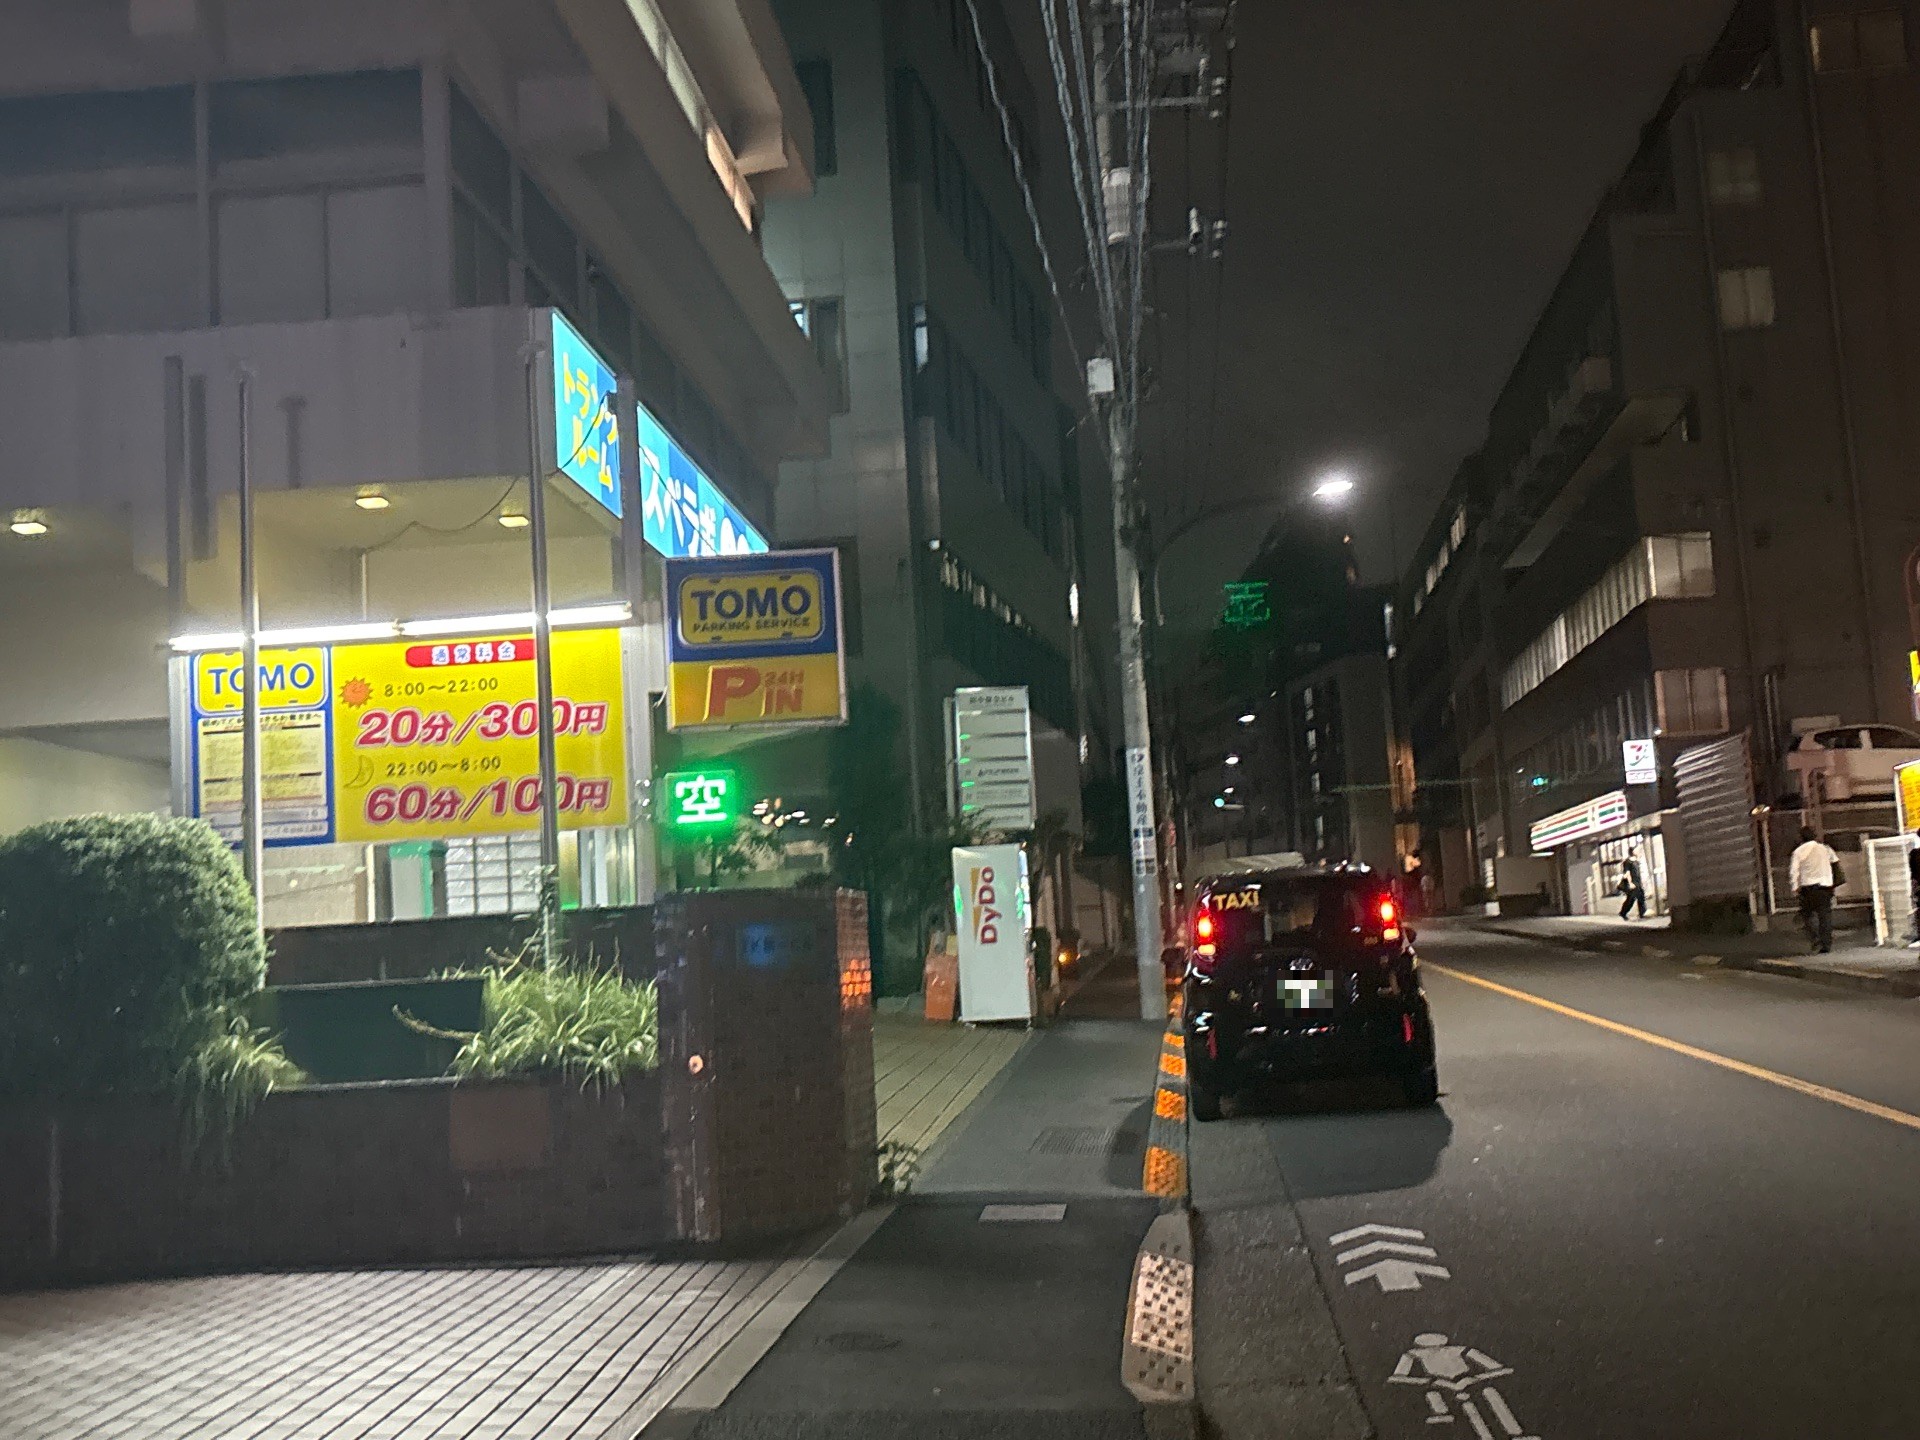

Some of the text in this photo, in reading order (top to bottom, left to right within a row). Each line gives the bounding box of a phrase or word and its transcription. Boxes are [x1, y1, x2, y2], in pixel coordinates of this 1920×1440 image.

[573, 415, 614, 494] ルーム
[691, 585, 811, 621] TOMO
[693, 618, 811, 633] PARKING SERVICE
[432, 641, 516, 665] 通常料金
[207, 663, 315, 695] TOMO
[355, 698, 608, 748] 20分/300円
[366, 774, 612, 825] 60分/100円
[675, 774, 728, 824] 空
[978, 865, 1003, 945] DyDo
[1213, 890, 1260, 911] TAXI
